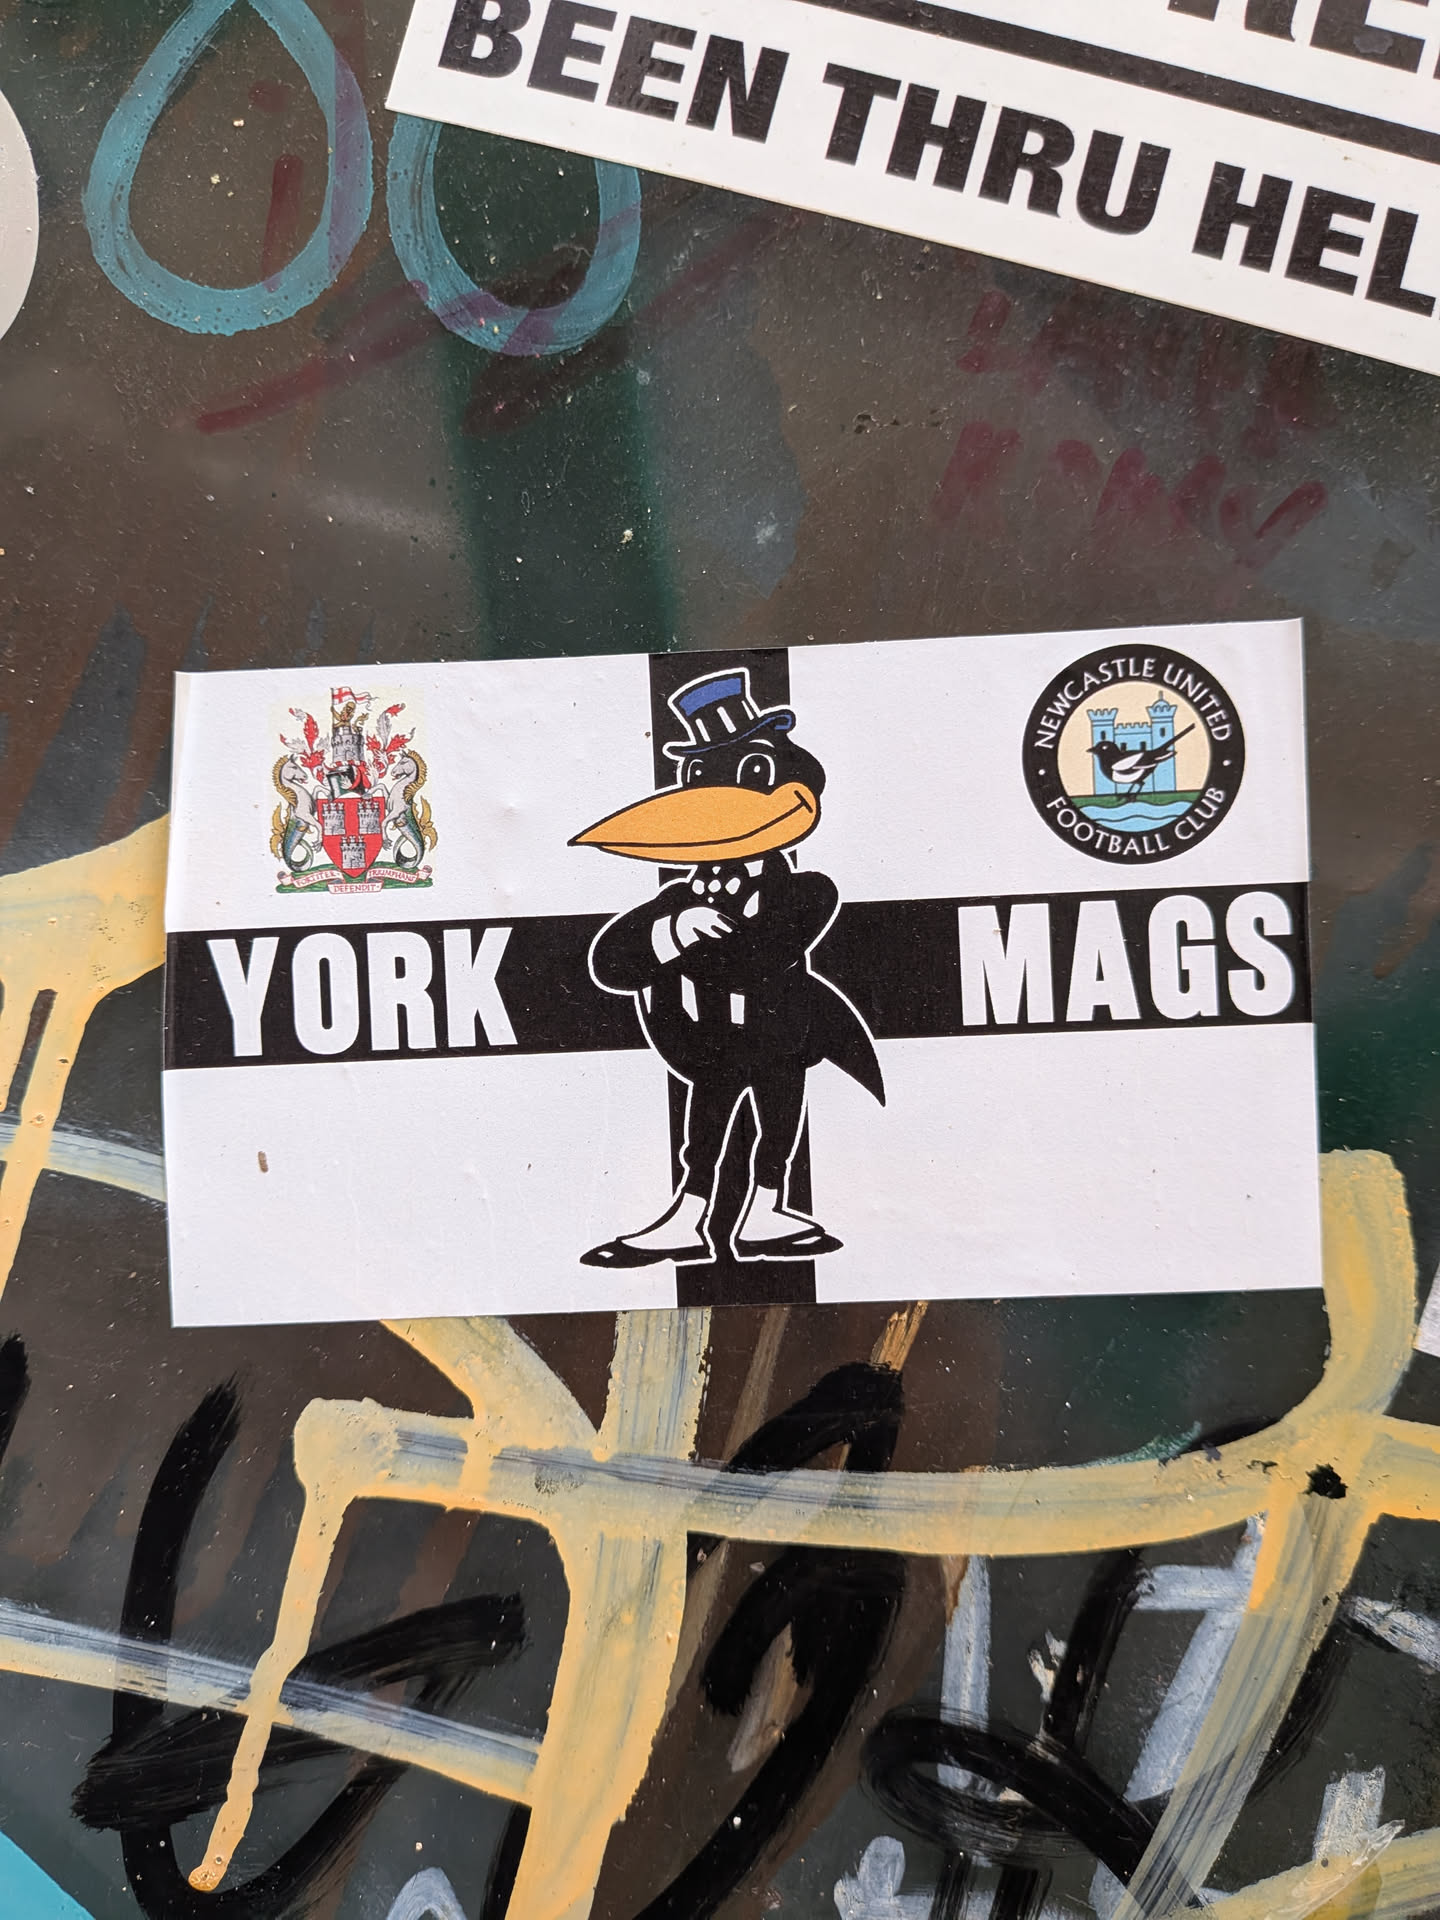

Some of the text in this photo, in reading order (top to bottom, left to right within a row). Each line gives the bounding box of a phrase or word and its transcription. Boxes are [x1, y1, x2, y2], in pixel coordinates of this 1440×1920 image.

[437, 0, 1440, 319] BEEN THRU HEL
[1034, 657, 1232, 749] NEWCASTLE UNITED
[1046, 787, 1226, 856] FOOTBALL CLUB
[333, 883, 376, 893] DEFENDIT
[206, 891, 1296, 1057] YORK MAGS
